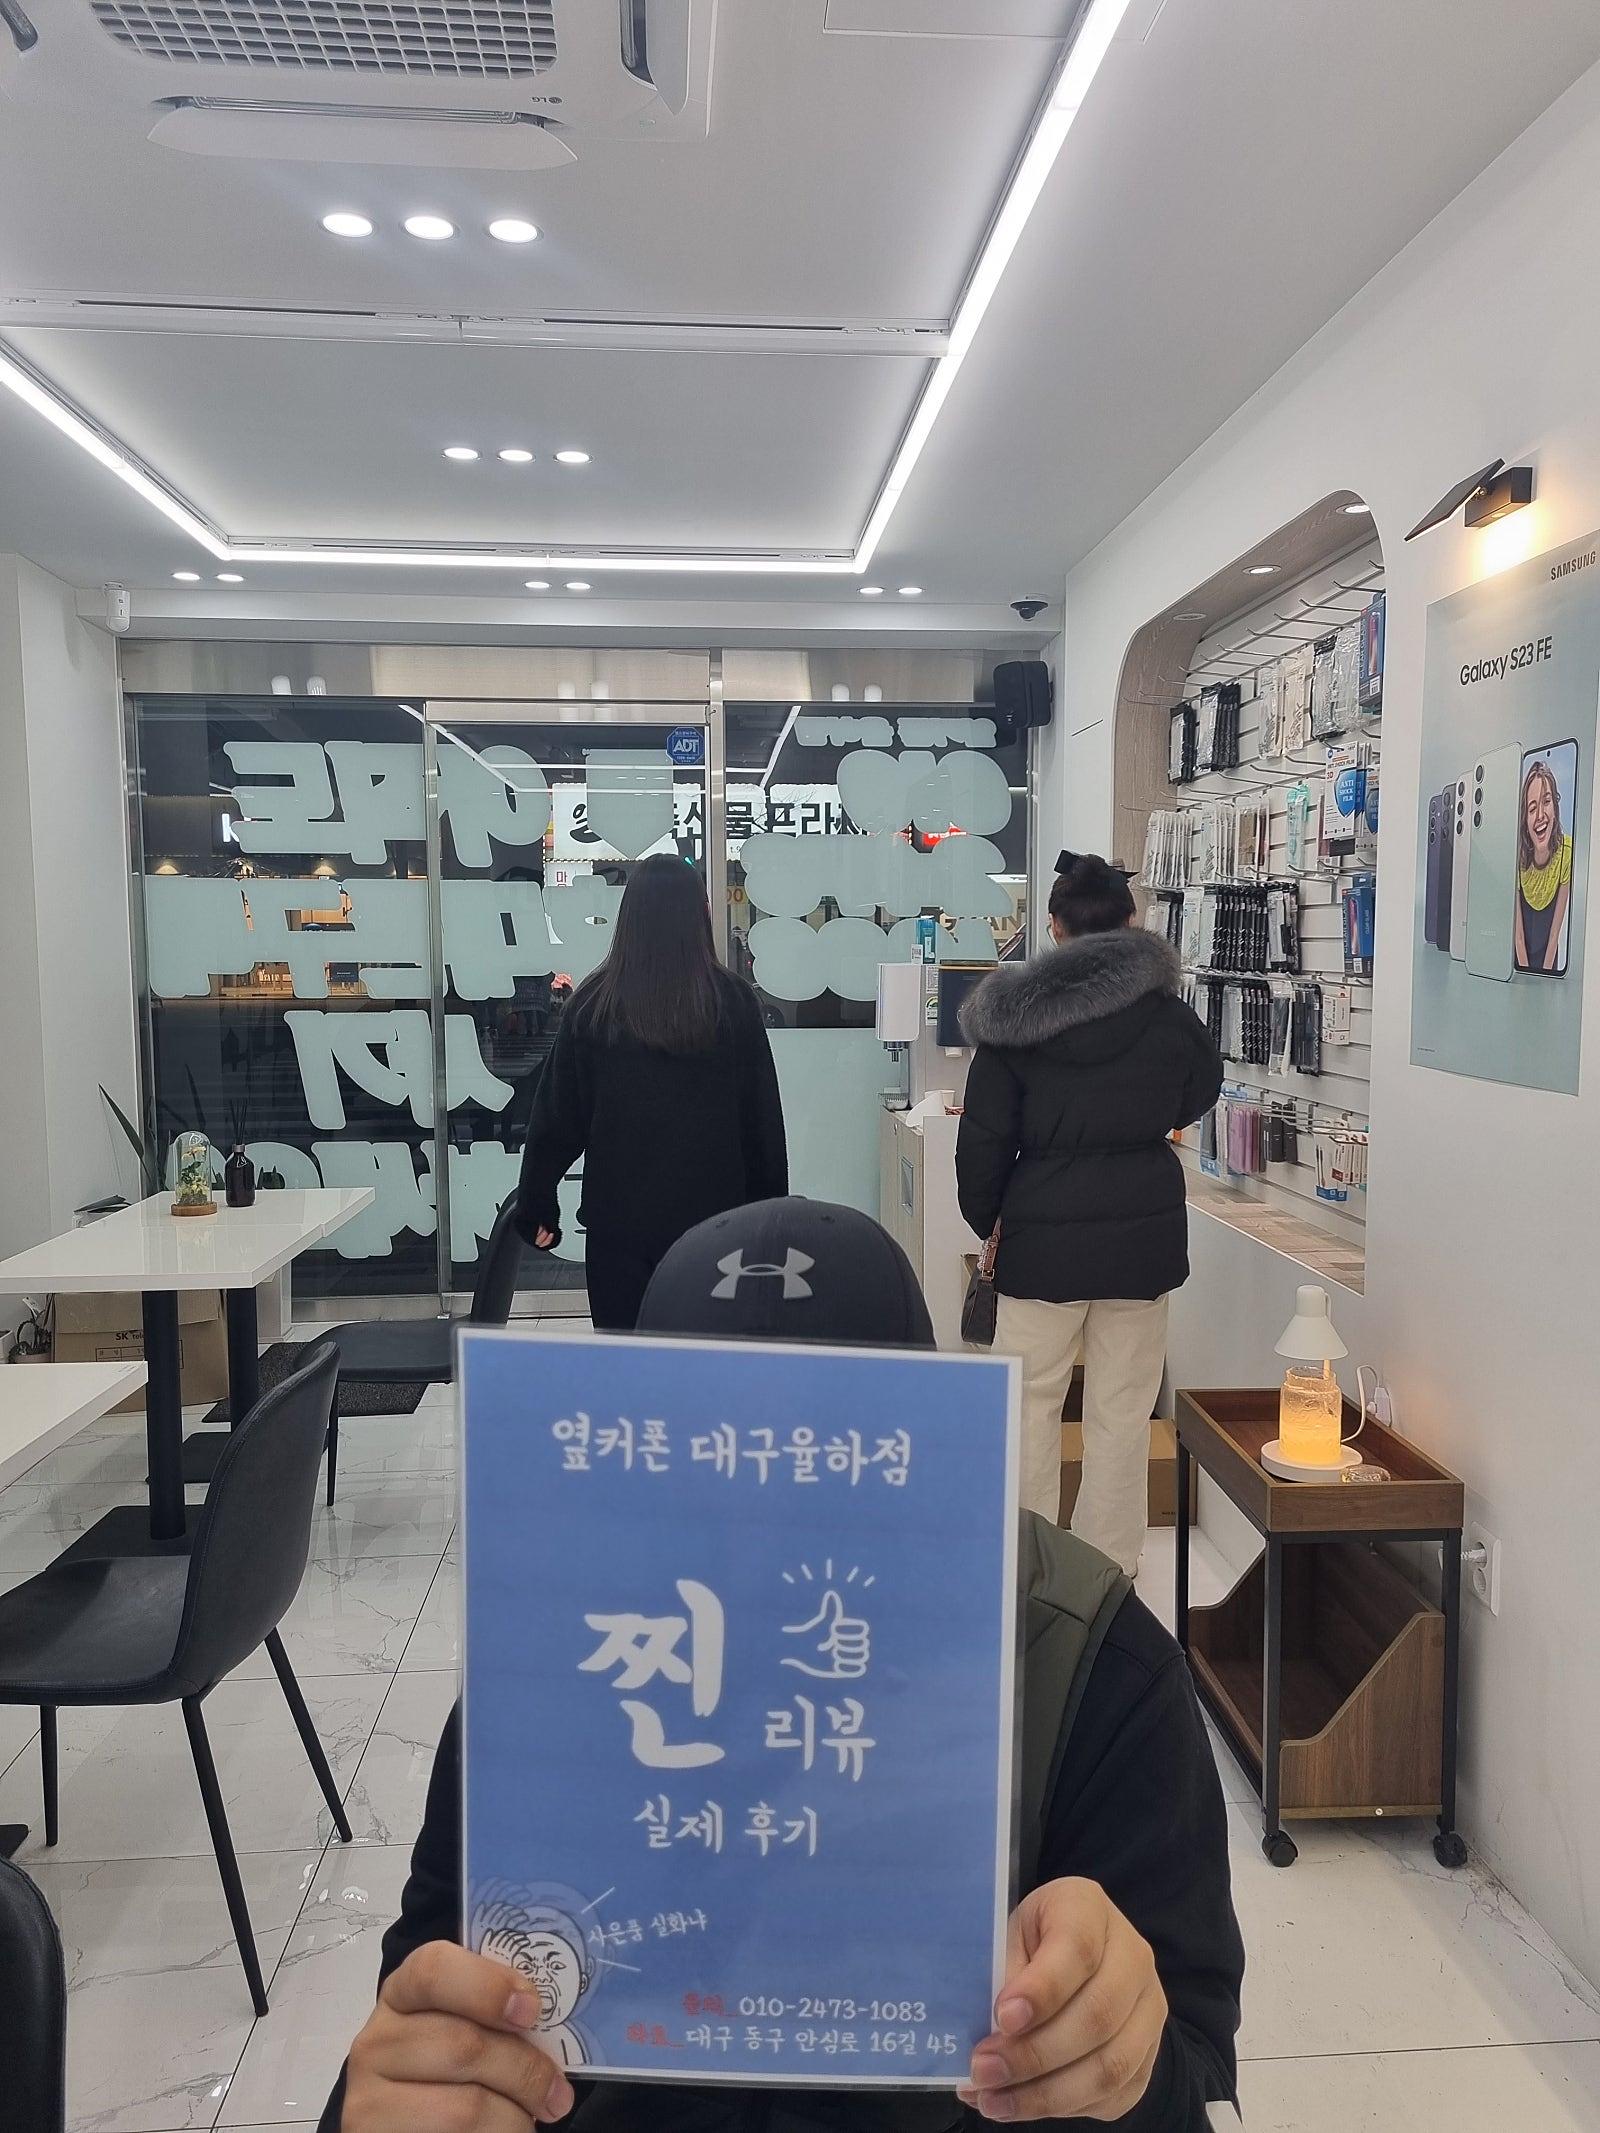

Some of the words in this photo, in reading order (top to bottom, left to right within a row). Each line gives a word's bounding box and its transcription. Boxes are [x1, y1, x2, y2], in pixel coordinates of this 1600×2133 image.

[1550, 550, 1596, 581] SAMSUNG
[1460, 654, 1508, 686] Galaxy
[1510, 642, 1534, 671] S23
[1536, 636, 1552, 662] FE
[672, 738, 699, 753] ADT
[1339, 788, 1354, 796] SHOCK
[1340, 780, 1354, 788] ANTI
[115, 1332, 129, 1340] SK
[552, 1411, 671, 1472] 옆커폰
[690, 1422, 912, 1486] 대구율하점
[577, 1578, 726, 1769] 찐
[764, 1694, 877, 1782] 리뷰
[633, 1793, 724, 1854] 실제
[744, 1800, 817, 1857] 후기
[738, 1995, 928, 2023] 010-2473-1083
[686, 2024, 734, 2052] 대구
[743, 2025, 786, 2054] 동구
[795, 2028, 861, 2055] 안심로
[869, 2029, 917, 2056] 16길
[926, 2032, 958, 2055] 45
